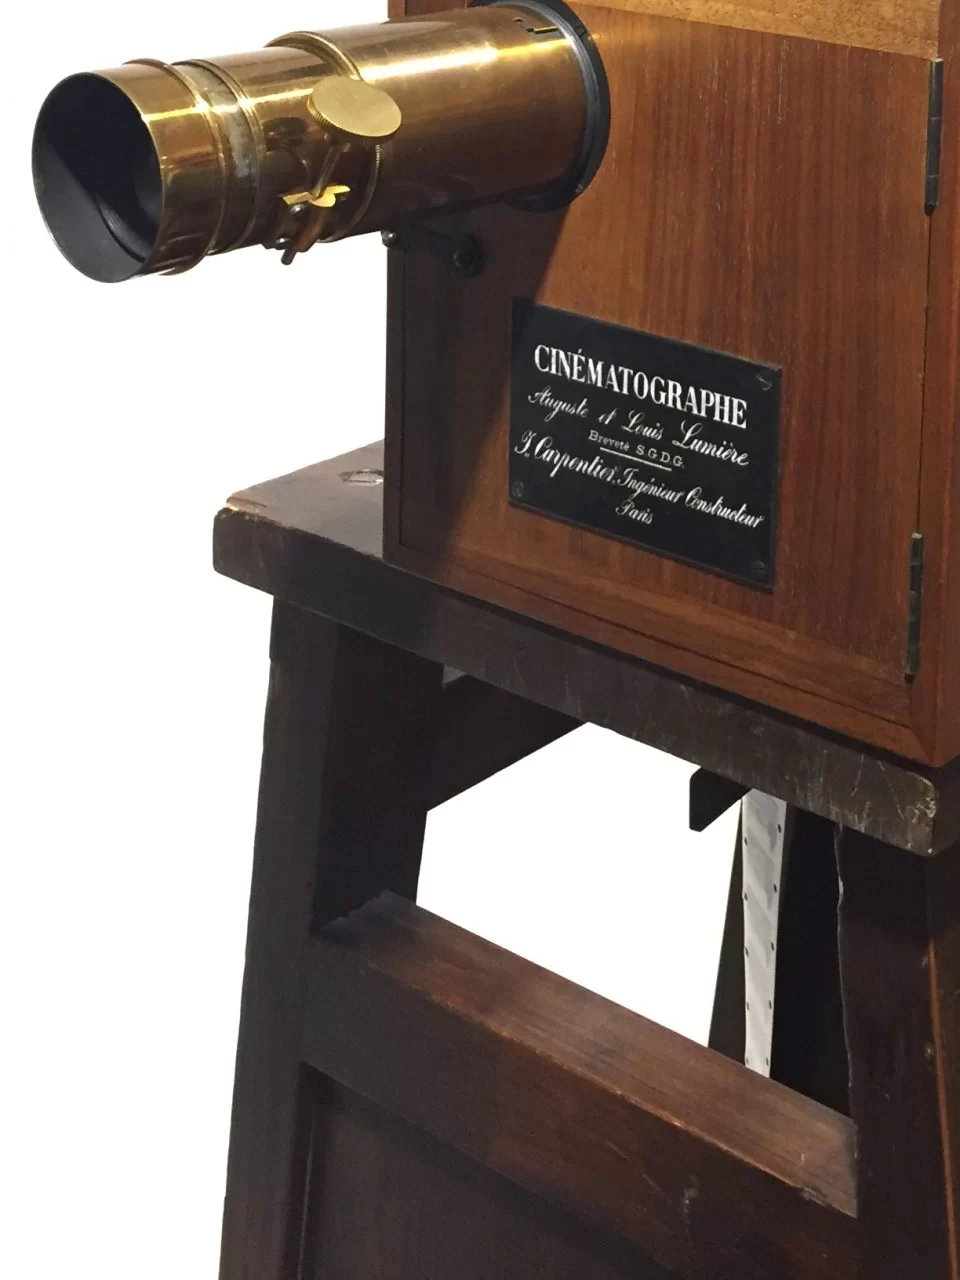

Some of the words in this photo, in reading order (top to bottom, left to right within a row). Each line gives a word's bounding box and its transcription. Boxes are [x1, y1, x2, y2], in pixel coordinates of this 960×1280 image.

[533, 343, 748, 429] CINÉMATOGRAPHE
[527, 385, 590, 423] Auguste
[597, 408, 618, 426] et
[620, 409, 665, 441] Louis
[671, 419, 751, 467] Lumière
[615, 498, 654, 525] Paris
[684, 486, 766, 529] Constructeur
